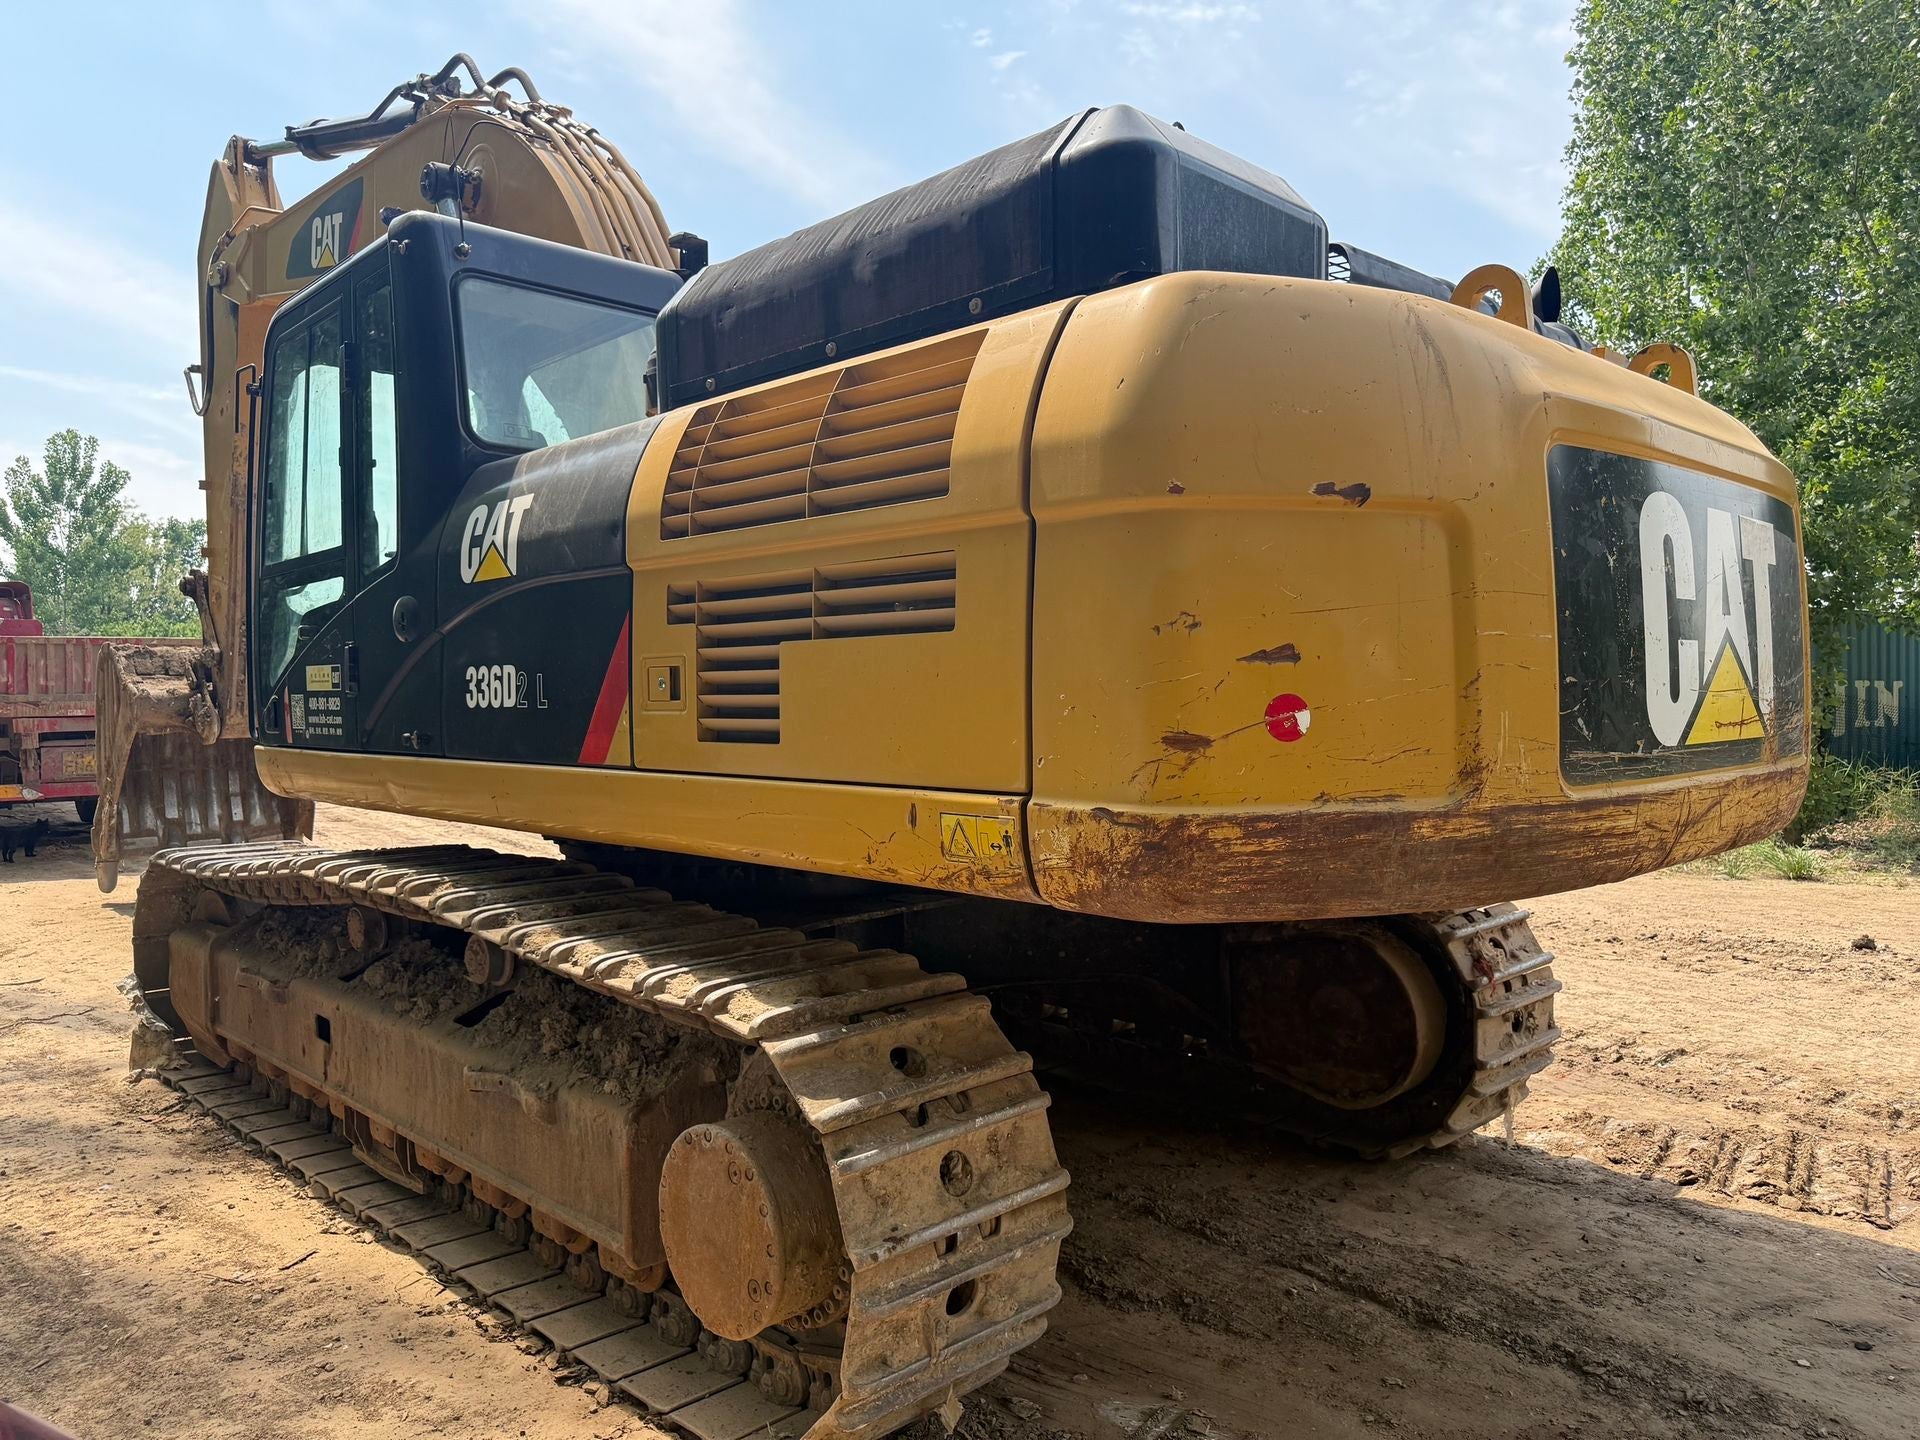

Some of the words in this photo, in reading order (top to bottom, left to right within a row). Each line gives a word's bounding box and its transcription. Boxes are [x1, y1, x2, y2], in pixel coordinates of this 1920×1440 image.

[311, 212, 343, 269] CAT
[460, 493, 535, 584] CAT
[1638, 490, 1777, 747] CAT
[536, 673, 548, 709] L
